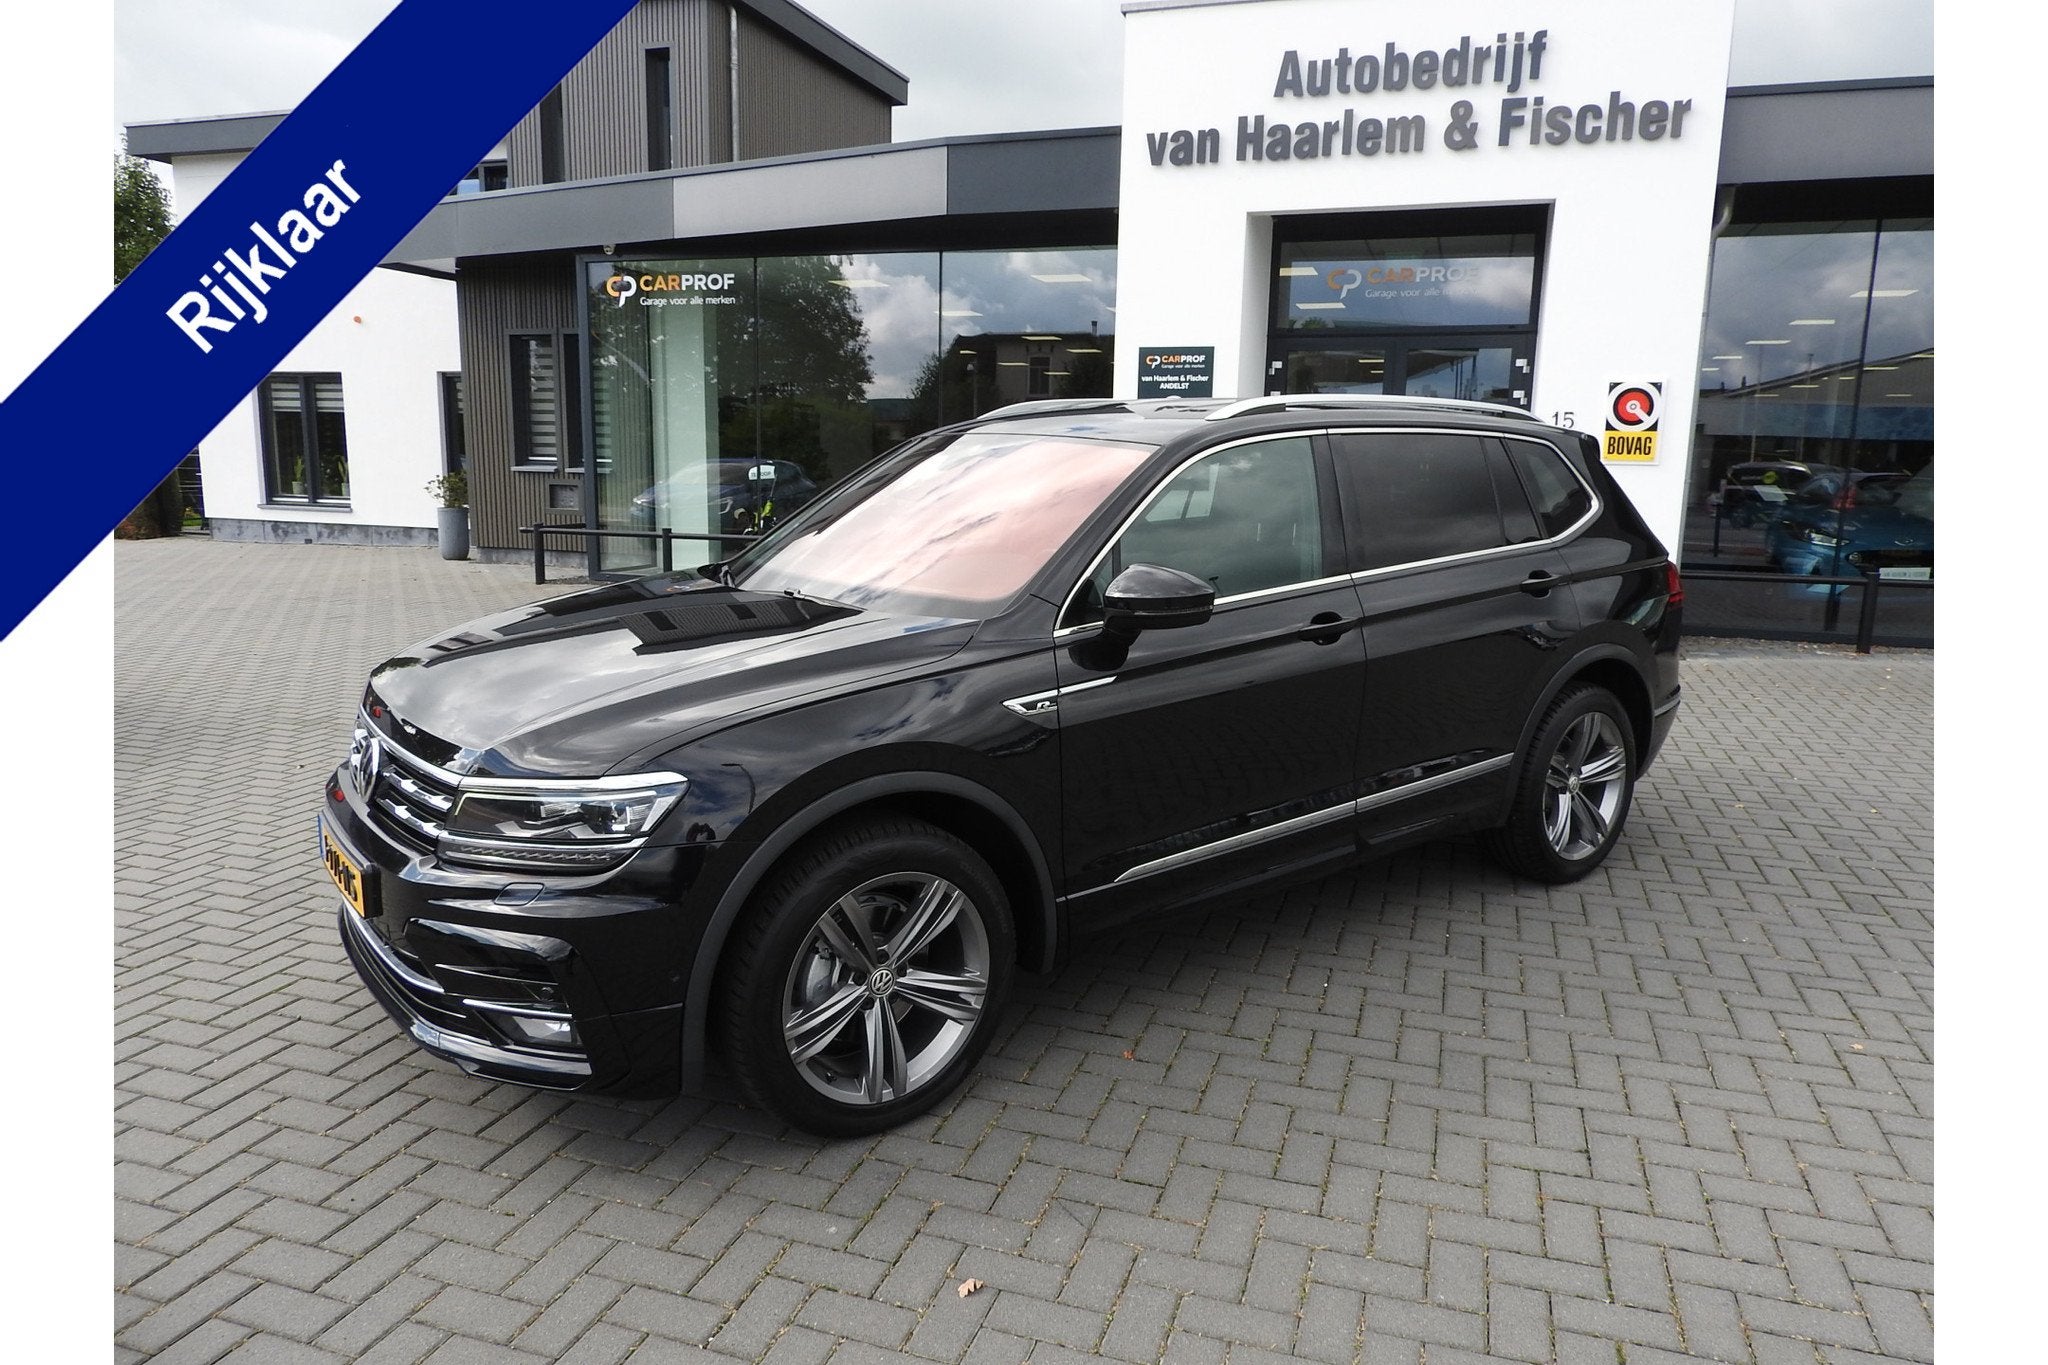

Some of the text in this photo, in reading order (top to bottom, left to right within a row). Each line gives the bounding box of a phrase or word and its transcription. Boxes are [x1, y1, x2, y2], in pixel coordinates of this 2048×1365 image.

[1273, 29, 1548, 97] Autobedrijf
[1146, 90, 1692, 166] van Haarlem & Fischer
[639, 273, 736, 291] CARPROF
[1364, 288, 1398, 299] Garage
[1400, 289, 1420, 297] voor
[639, 296, 668, 307] Garage
[690, 296, 704, 305] alle
[705, 295, 736, 305] merken
[1161, 354, 1206, 363] CARPROF
[1153, 374, 1180, 382] Haarlem
[1180, 374, 1186, 382] &
[1186, 374, 1209, 382] Fischer
[1159, 382, 1190, 390] ANDELST
[1552, 411, 1575, 428] 15
[1606, 435, 1653, 456] BOVAG
